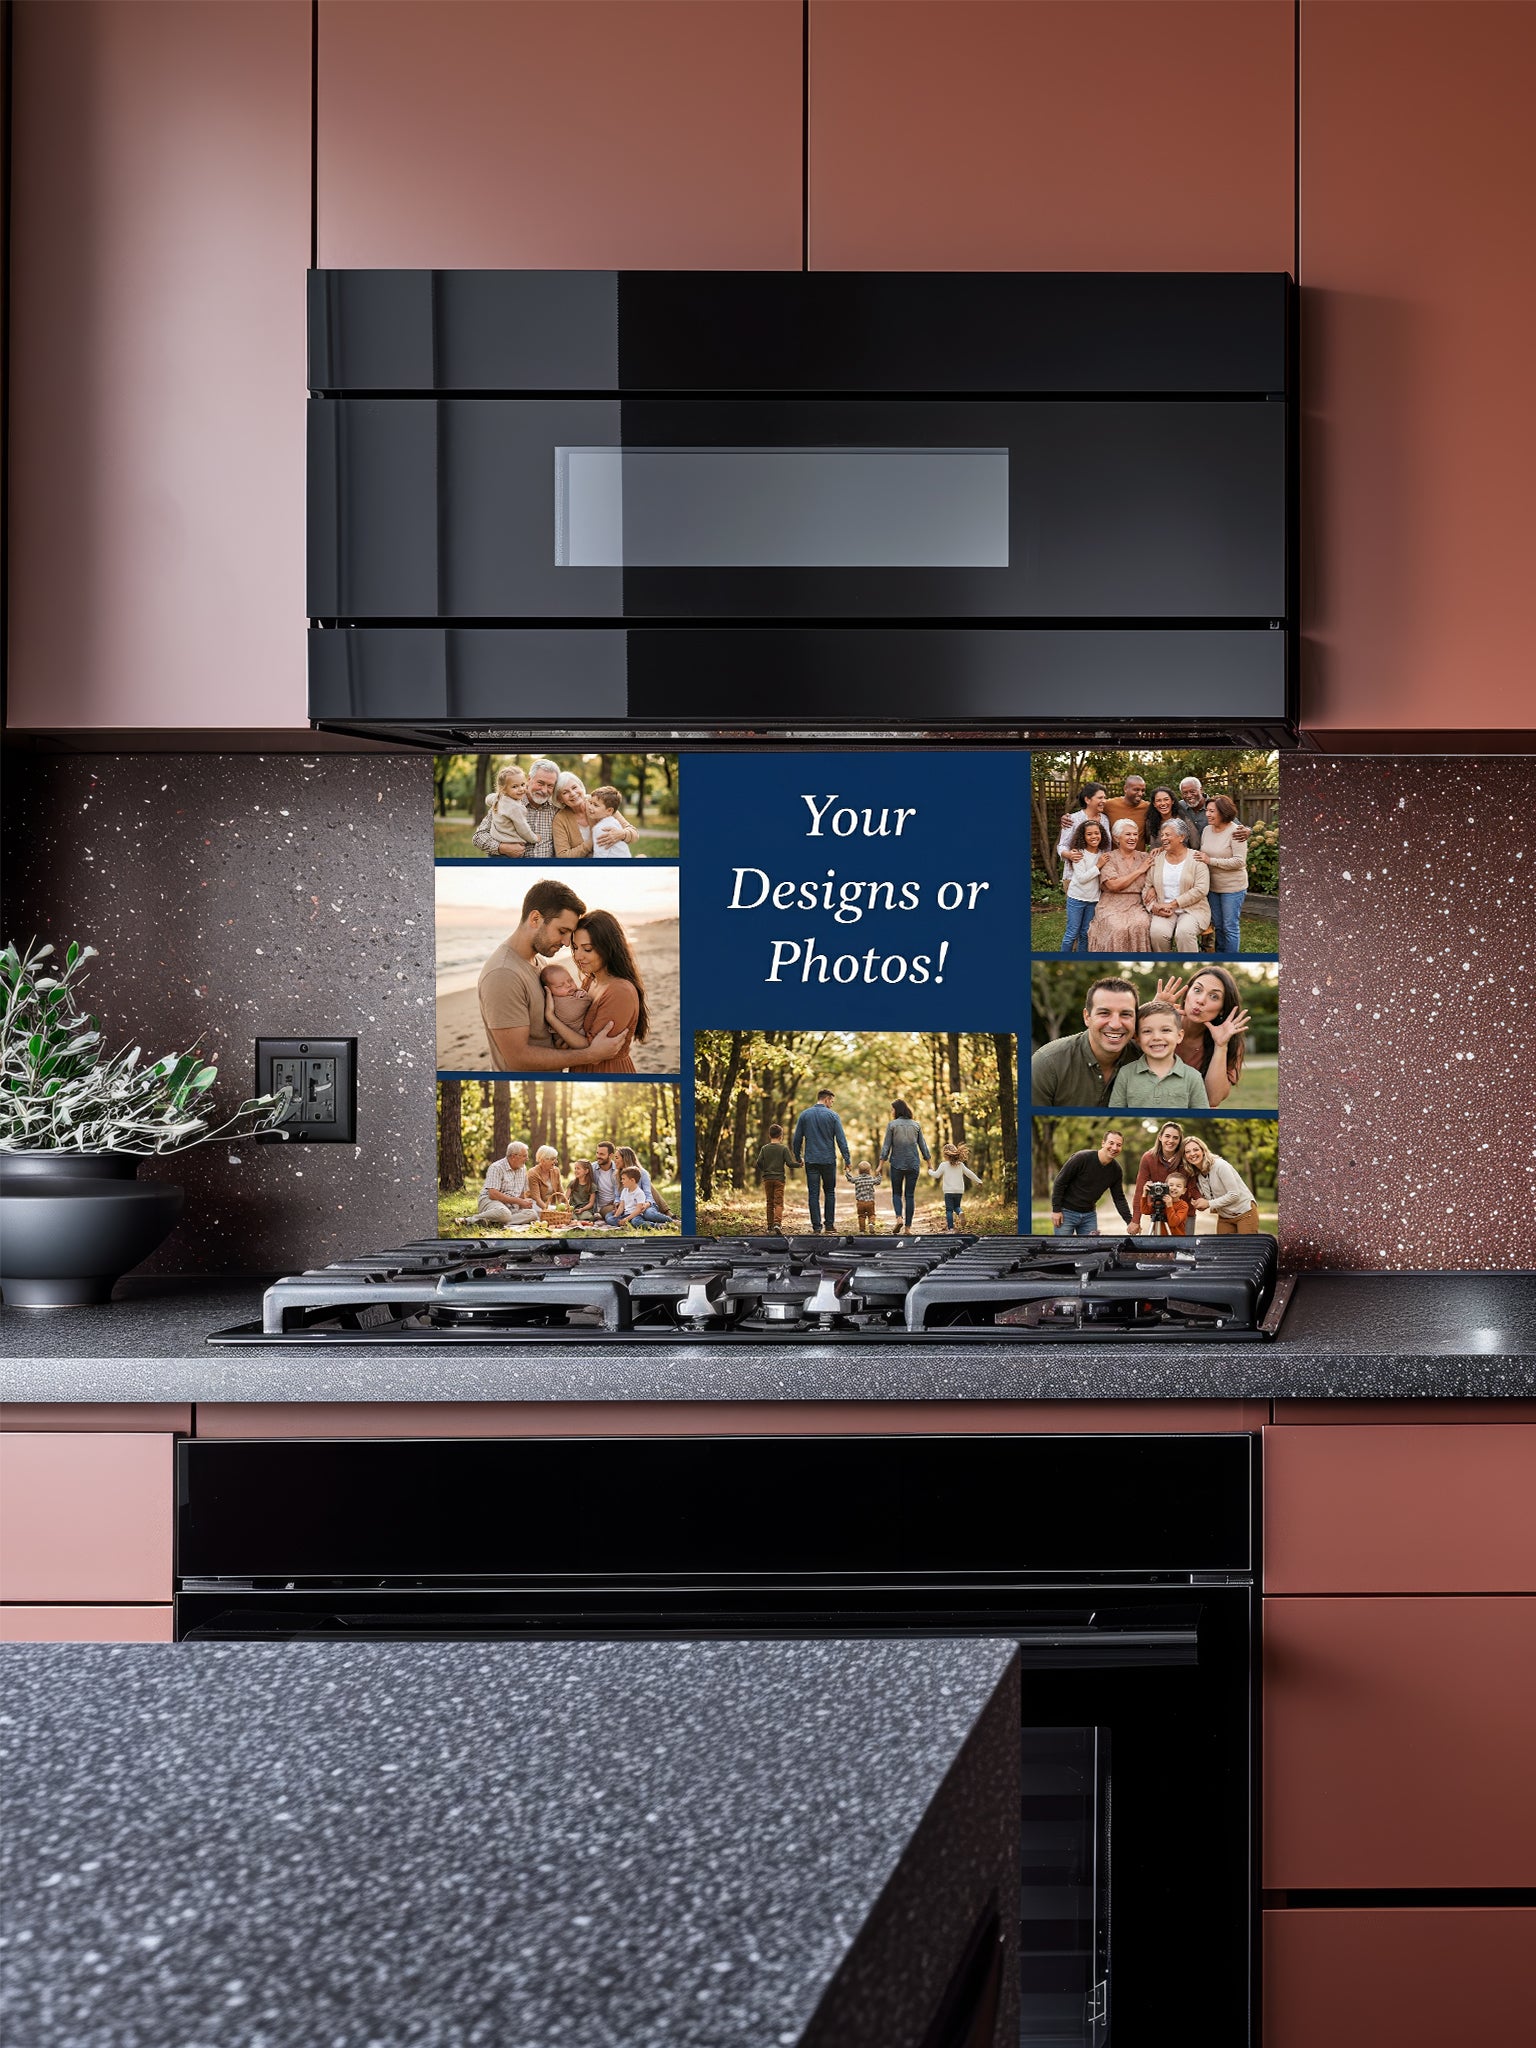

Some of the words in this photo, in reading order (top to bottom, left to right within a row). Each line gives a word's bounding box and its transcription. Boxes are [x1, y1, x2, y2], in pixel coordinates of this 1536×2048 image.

[801, 794, 917, 837] Your
[727, 867, 921, 924] Designs
[937, 881, 990, 911] or
[765, 937, 949, 984] Photos!
